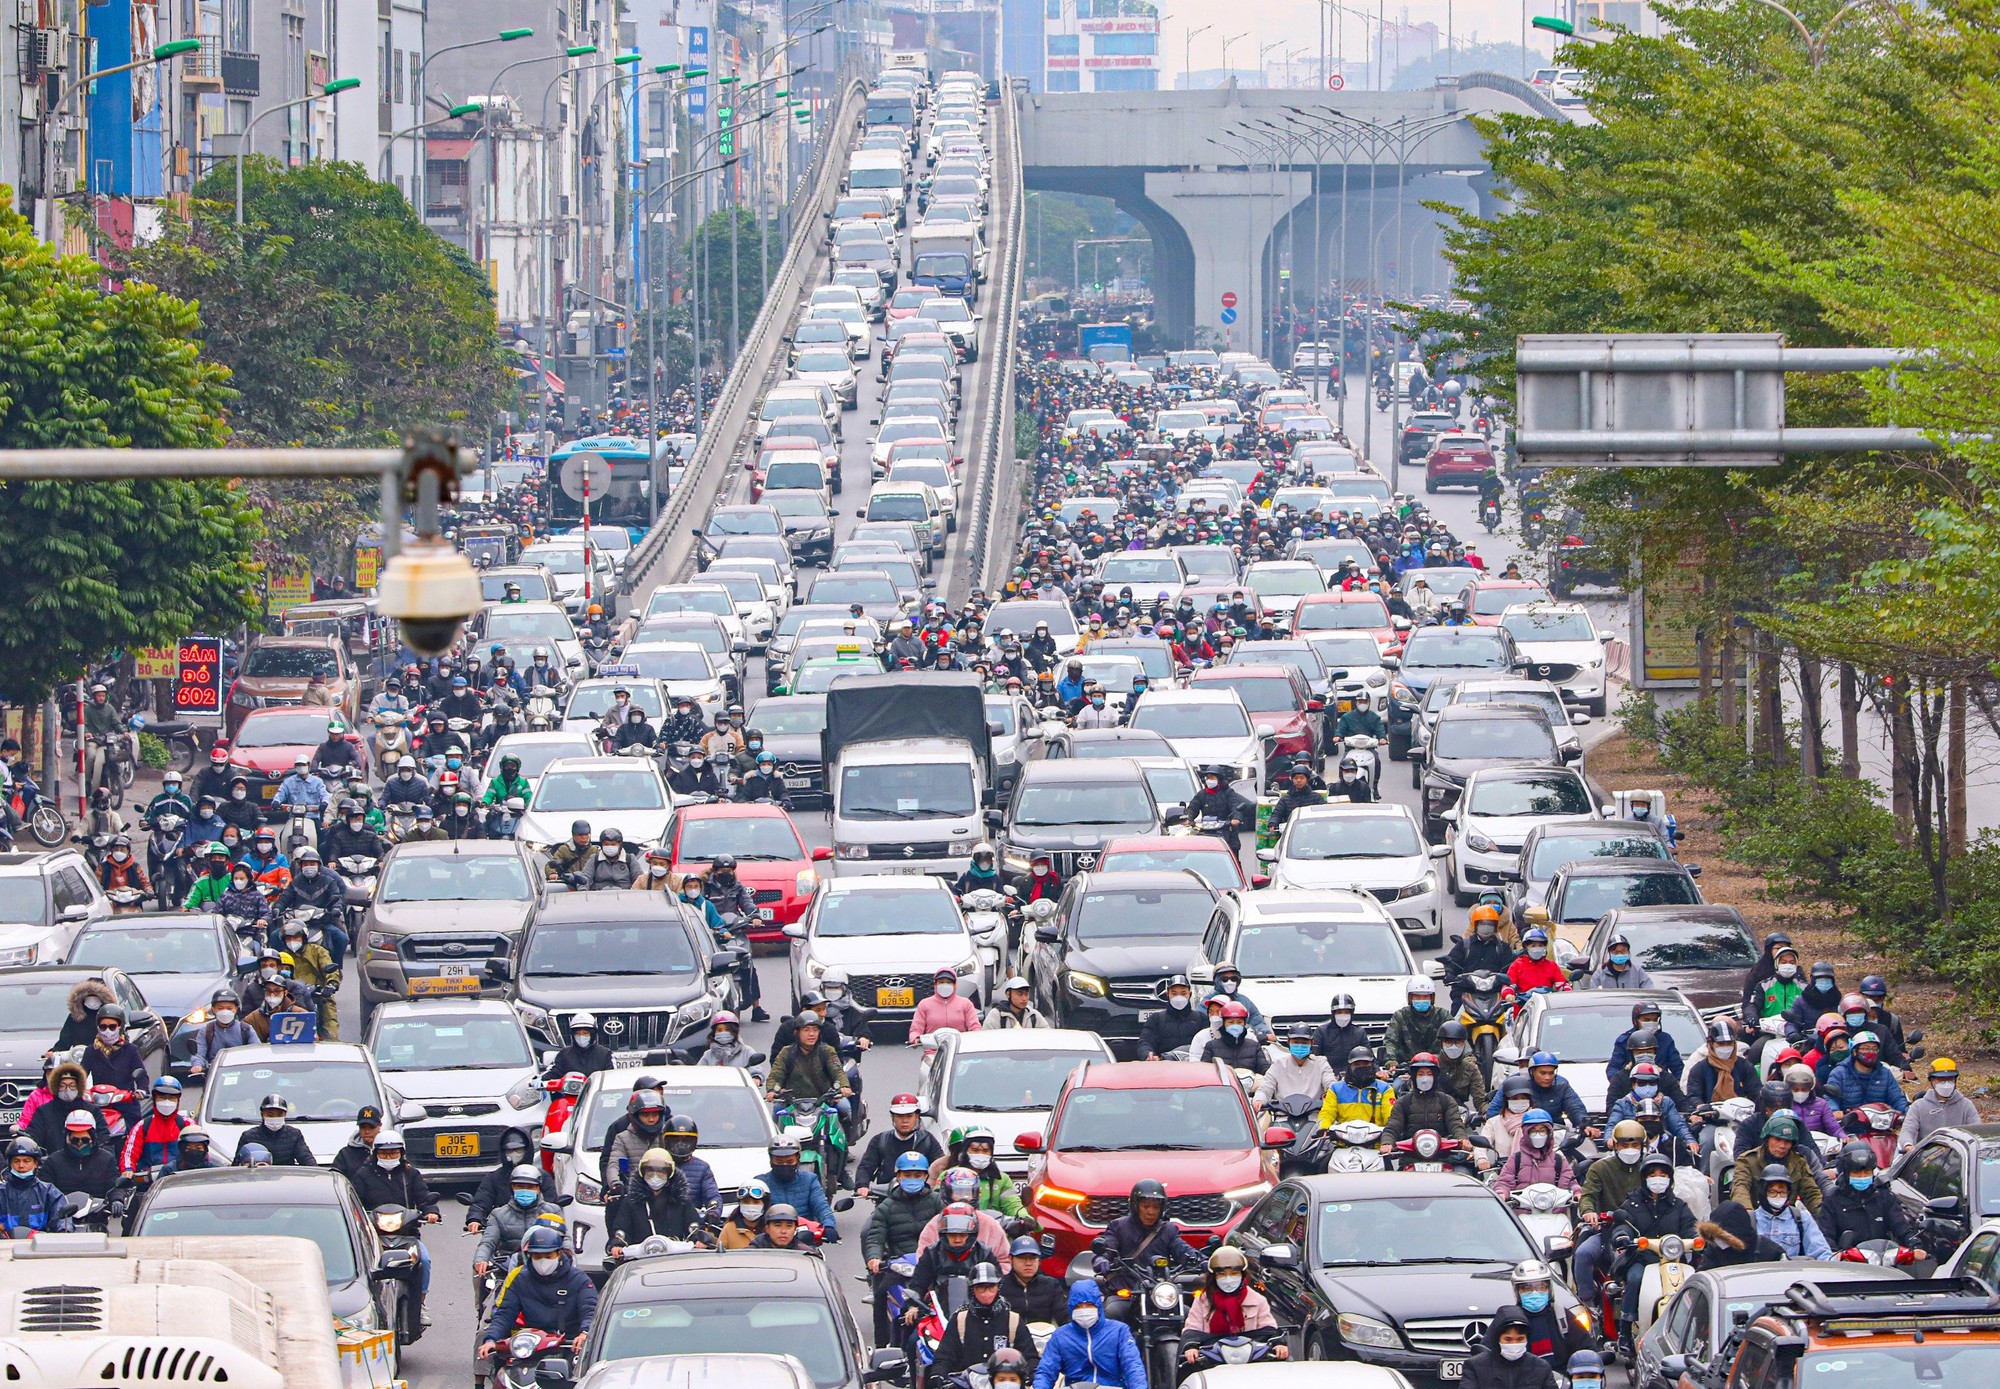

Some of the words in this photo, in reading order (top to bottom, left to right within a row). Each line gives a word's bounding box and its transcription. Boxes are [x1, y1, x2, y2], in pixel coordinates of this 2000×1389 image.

[358, 561, 374, 570] KIM
[177, 687, 217, 705] 602
[726, 742, 735, 753] B
[446, 966, 464, 976] 29H
[448, 1135, 467, 1145] 30E
[440, 1145, 474, 1155] 807.67
